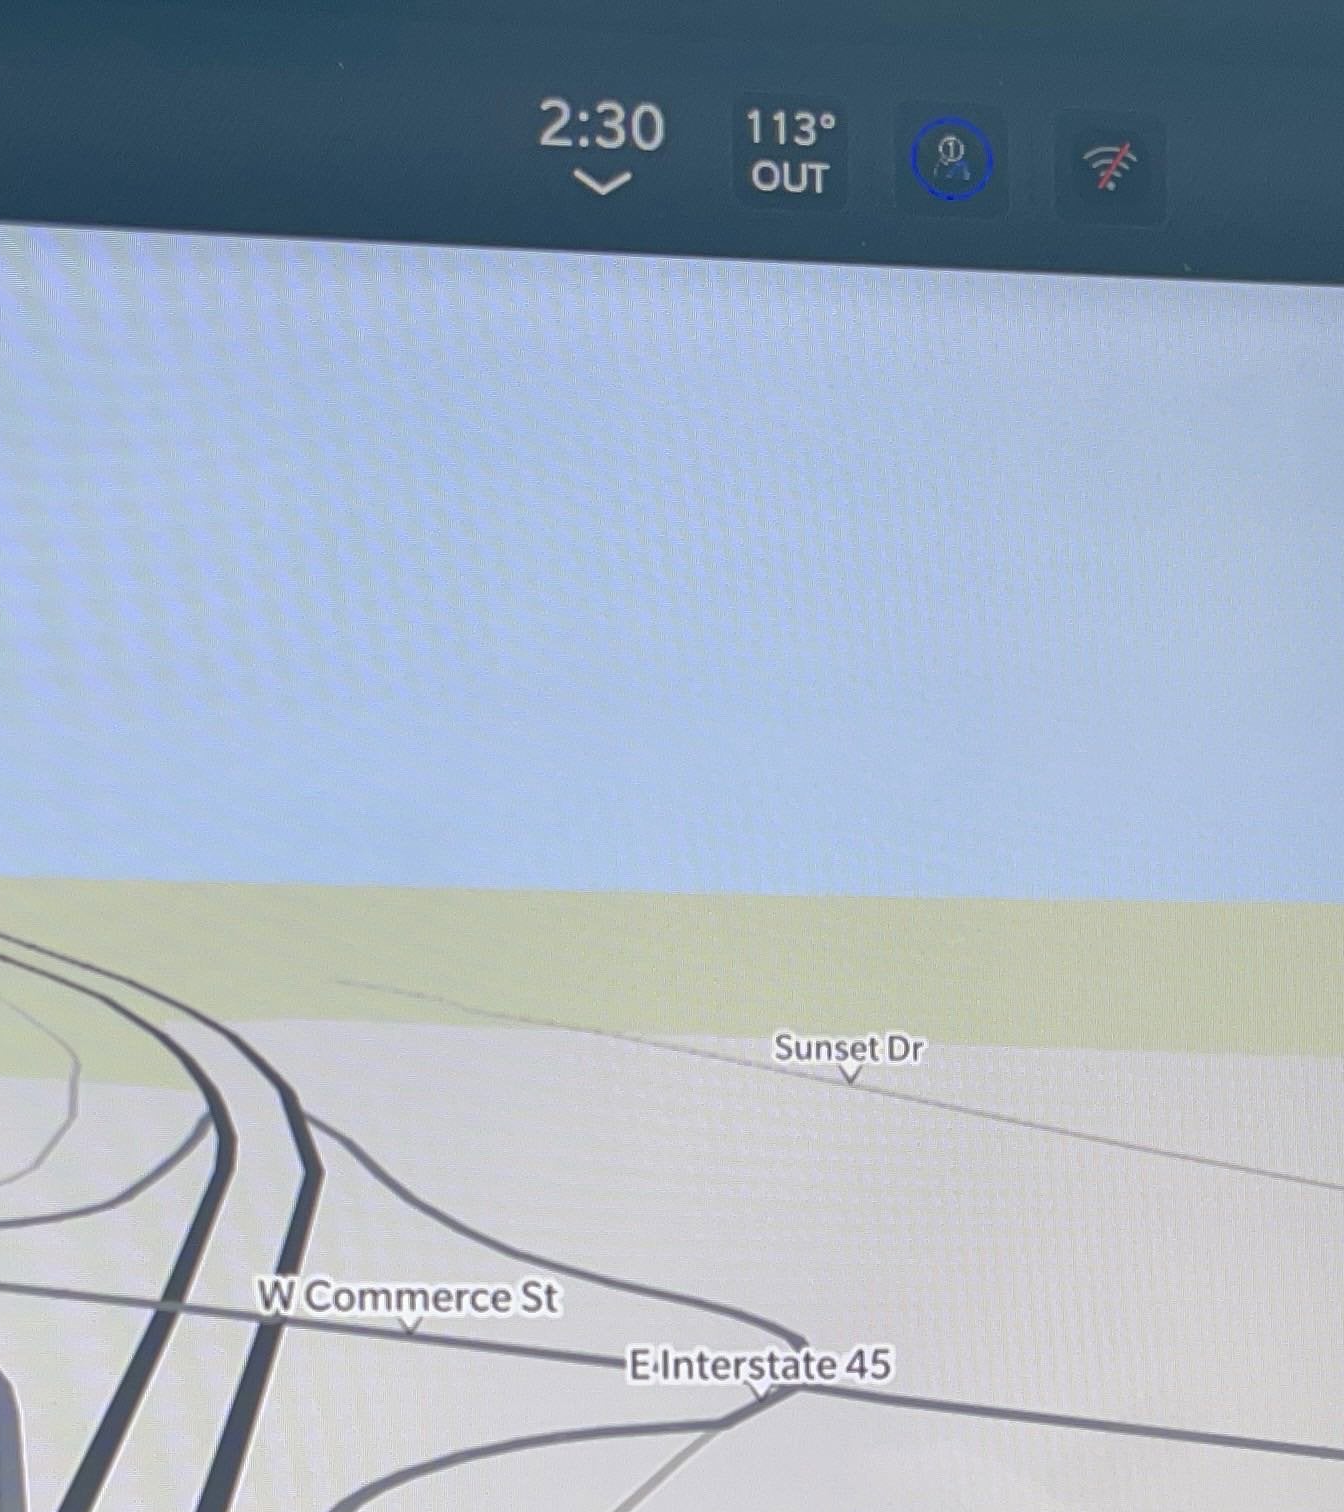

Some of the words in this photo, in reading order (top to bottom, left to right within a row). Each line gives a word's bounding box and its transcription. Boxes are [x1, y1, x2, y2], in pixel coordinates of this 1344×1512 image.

[540, 99, 664, 151] 2:30
[747, 110, 836, 146] 113°
[752, 161, 829, 194] OUT
[775, 1033, 880, 1062] Sunset
[888, 1034, 924, 1062] Dr
[258, 1281, 296, 1311] W
[306, 1281, 511, 1314] Commerce
[522, 1283, 559, 1313] St
[630, 1349, 651, 1379] E
[662, 1349, 836, 1381] Interstate
[845, 1349, 891, 1380] 45
